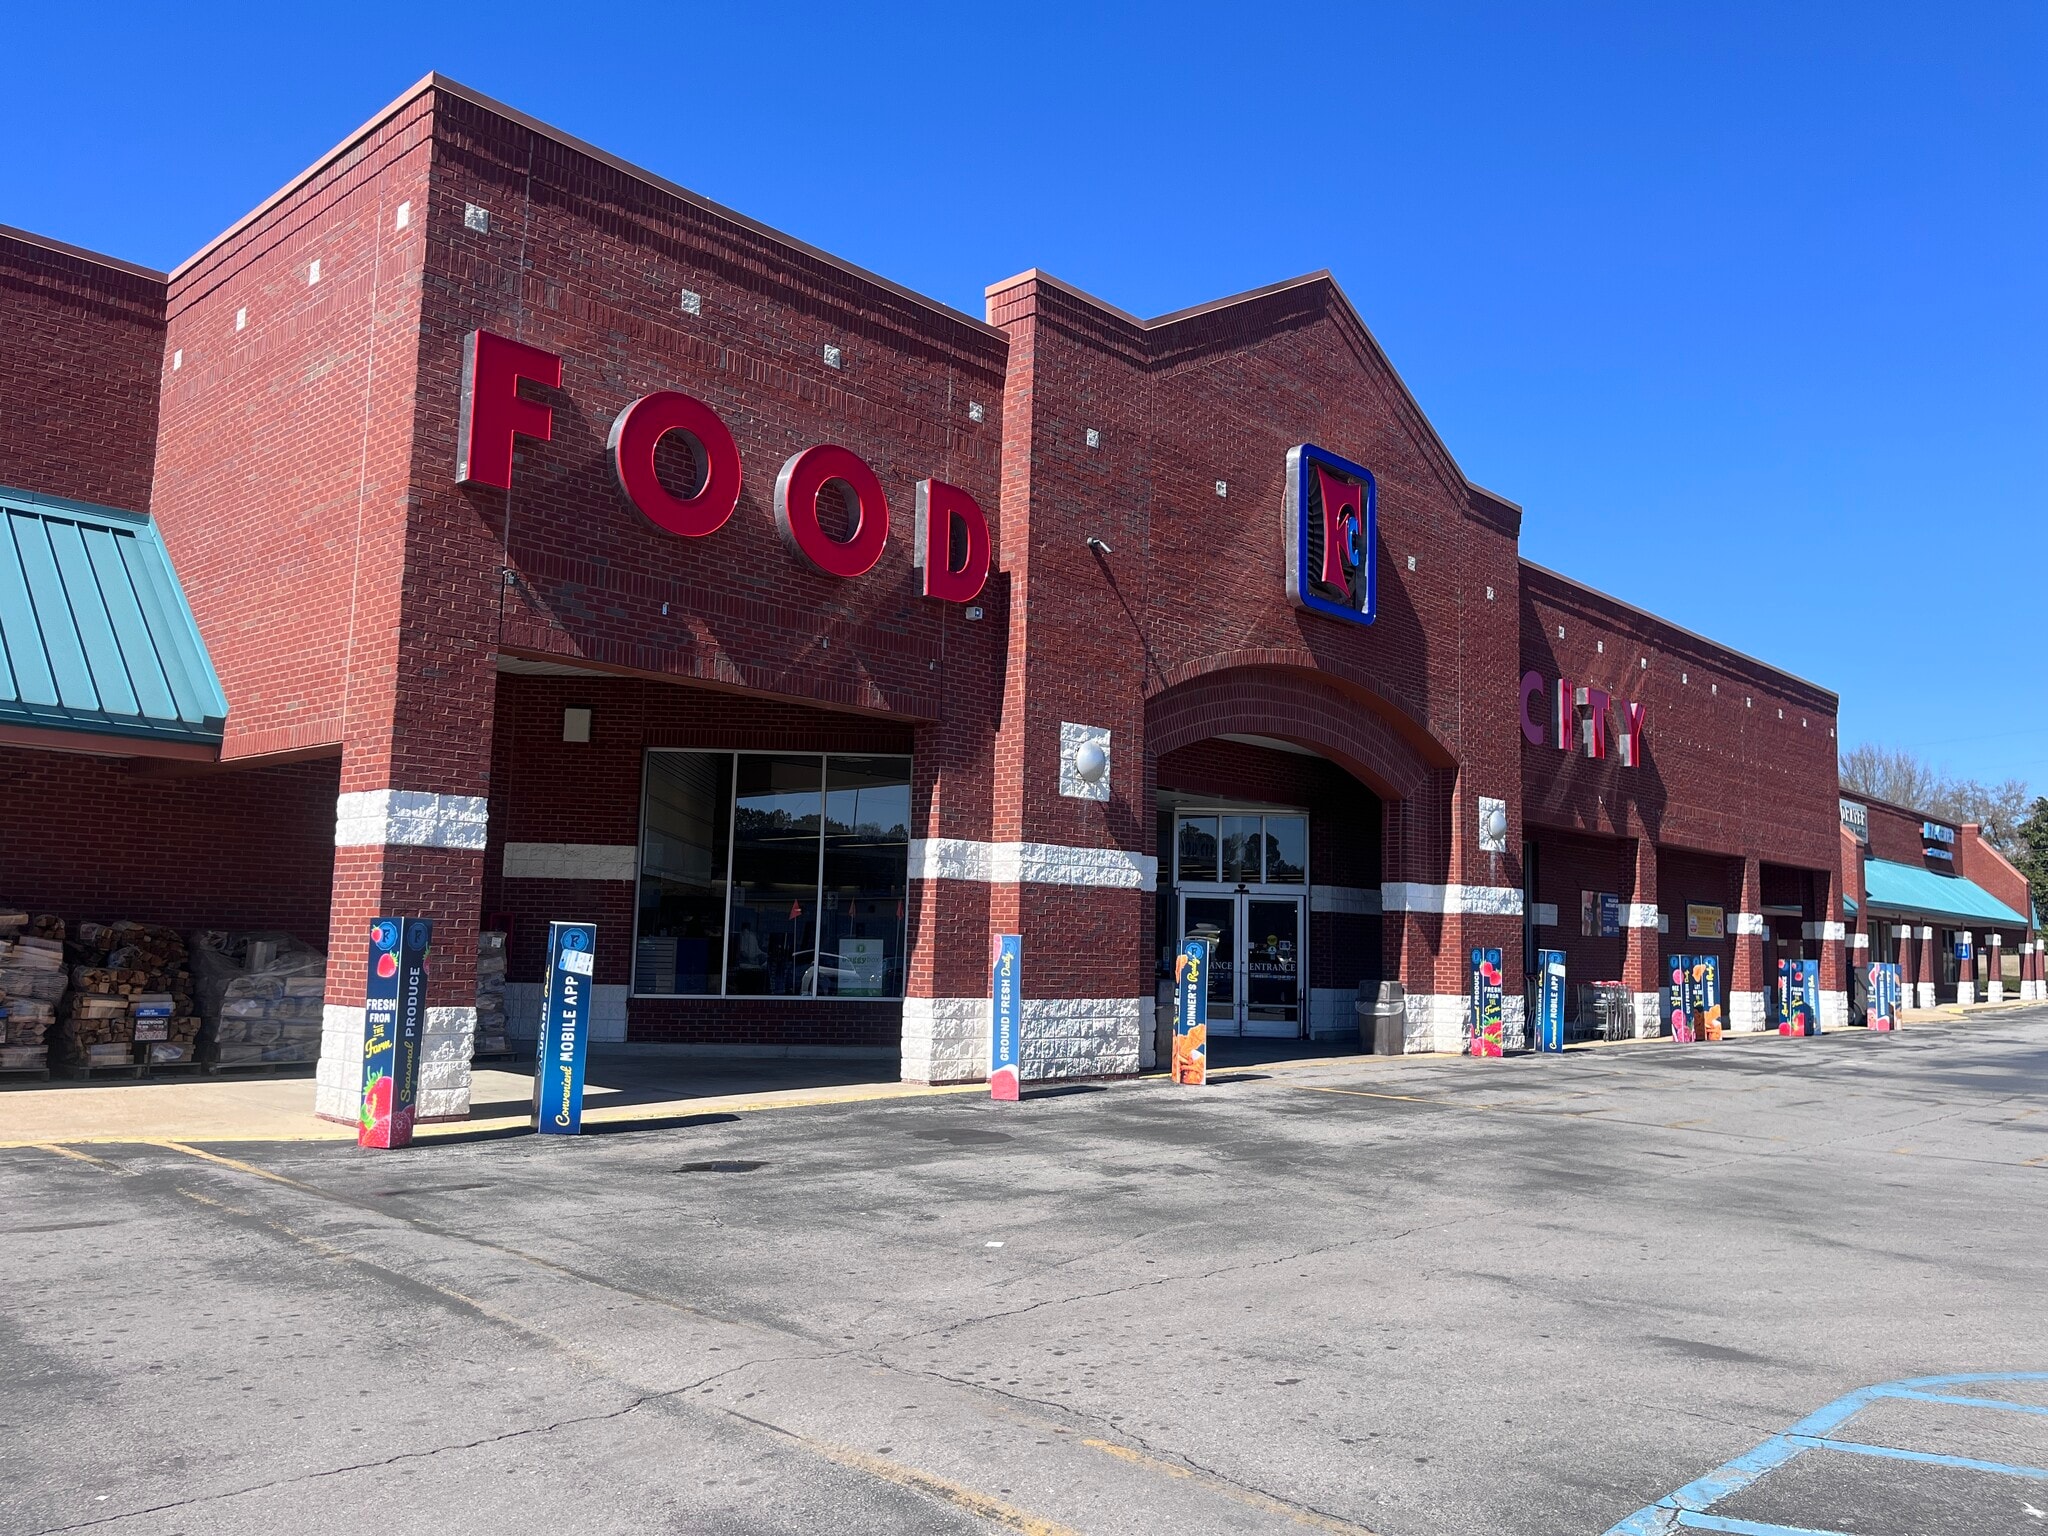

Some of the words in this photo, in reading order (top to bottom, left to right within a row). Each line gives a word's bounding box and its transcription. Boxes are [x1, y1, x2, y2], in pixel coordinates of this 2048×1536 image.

[455, 328, 991, 603] FOOD
[1519, 669, 1646, 768] CITY
[1000, 951, 1014, 977] Daily
[1249, 962, 1296, 972] ENTRANCE
[563, 975, 579, 1006] APP
[1001, 979, 1011, 1015] FRESH
[1550, 975, 1559, 991] APP
[366, 998, 396, 1011] FRESH
[369, 1012, 391, 1023] FROM
[405, 967, 420, 1037] PRODUCE
[1187, 983, 1198, 1026] DINNER'S
[1550, 991, 1558, 1019] MOBILE
[365, 1037, 392, 1059] Farm
[560, 1010, 577, 1062] MOBILE
[1000, 1016, 1010, 1061] GROUND
[400, 1041, 414, 1103] Seasonal
[555, 1065, 572, 1127] Convenient
